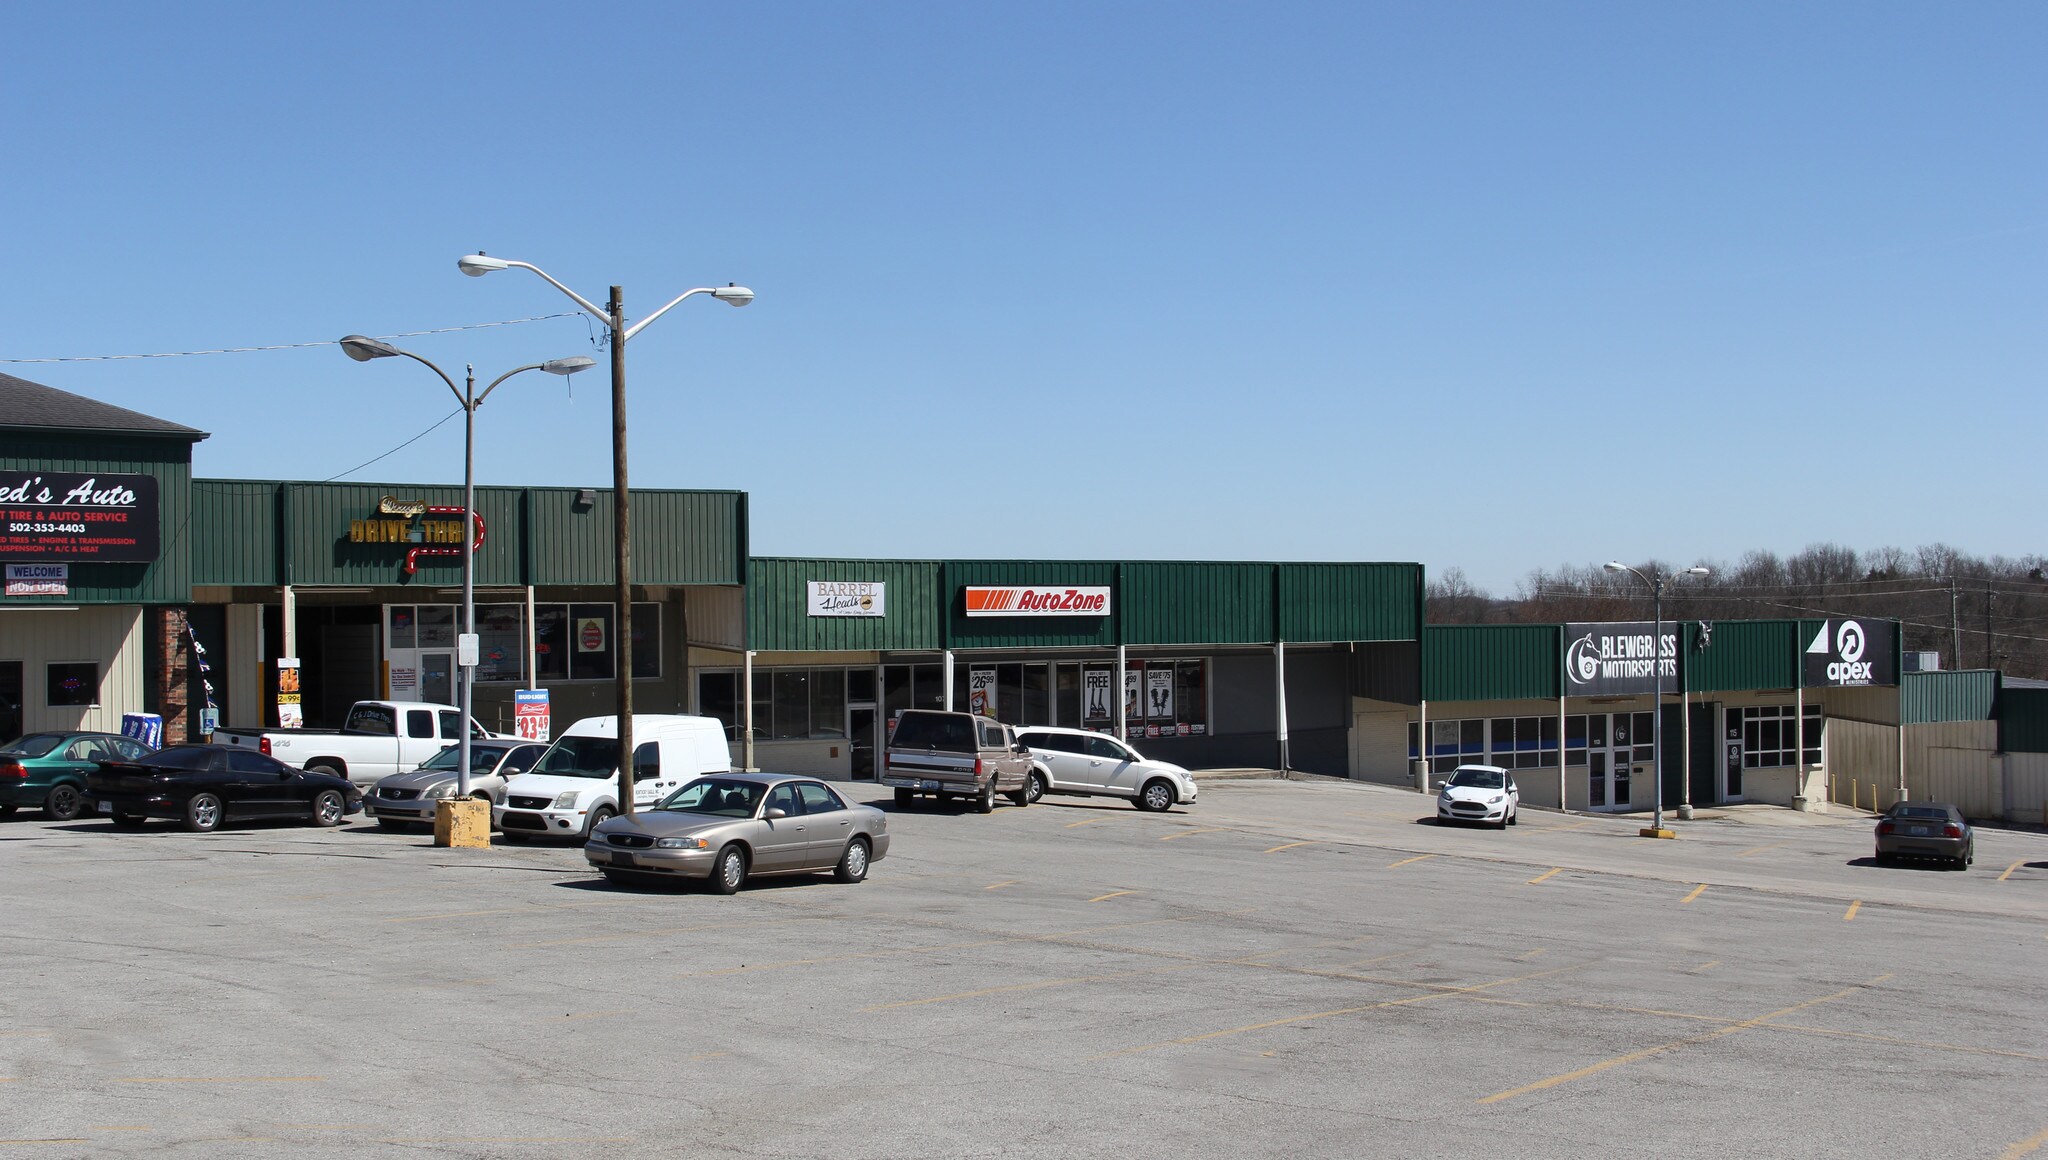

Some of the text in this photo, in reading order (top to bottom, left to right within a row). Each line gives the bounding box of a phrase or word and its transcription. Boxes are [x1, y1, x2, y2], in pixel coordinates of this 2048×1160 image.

[62, 478, 137, 505] Auto
[9, 511, 33, 521] TIRE
[36, 511, 45, 521] &
[48, 512, 81, 521] AUTO
[84, 512, 128, 522] SERVICE
[9, 523, 86, 533] 502-353-4403
[350, 519, 413, 543] DRIVE
[79, 538, 136, 546] TRANSMISSION
[0, 545, 46, 553] USPENSION
[14, 566, 63, 577] WELCOME
[10, 580, 66, 592] NOW OPEN
[817, 583, 878, 597] BARREL
[819, 595, 859, 612] Heads
[1017, 589, 1107, 611] AutoZone
[1602, 659, 1677, 678] MOTORSPORTS
[1826, 661, 1873, 685] apex
[1087, 675, 1109, 689] FREE
[1148, 671, 1162, 680] SAVE
[367, 710, 379, 718] Drive
[380, 712, 392, 724] Thru
[1147, 727, 1159, 736] FREE
[1178, 725, 1190, 734] FREE
